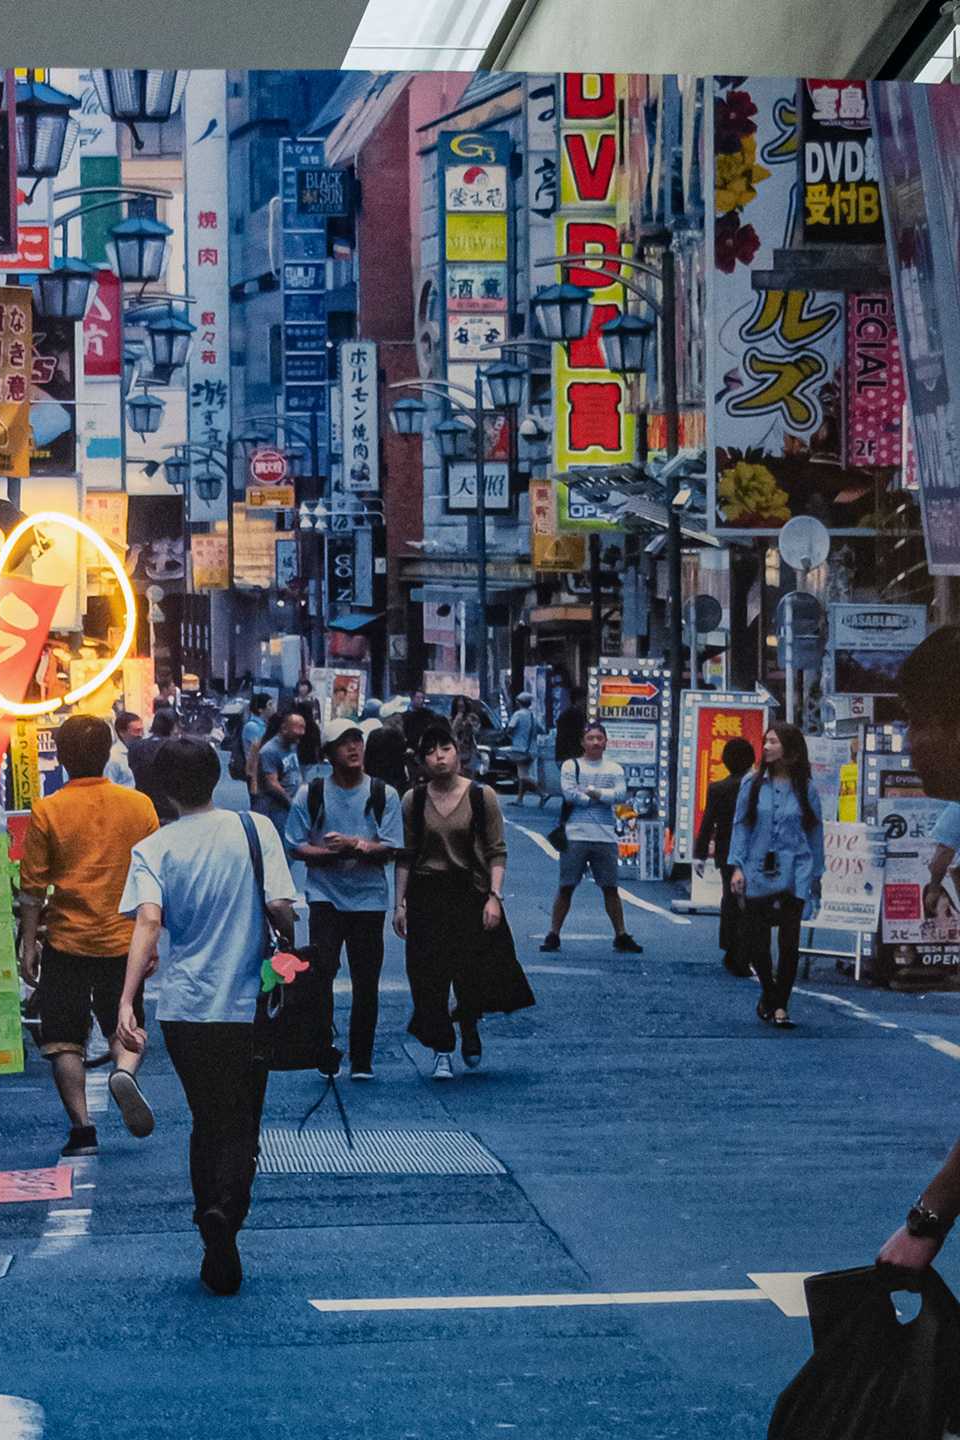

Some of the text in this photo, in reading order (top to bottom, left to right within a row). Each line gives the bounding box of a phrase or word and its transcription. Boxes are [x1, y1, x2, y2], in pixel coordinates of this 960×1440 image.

[805, 137, 880, 183] DVD
[306, 172, 343, 189] BLACK
[602, 706, 658, 719] ENTRANCE
[824, 833, 858, 851] ove
